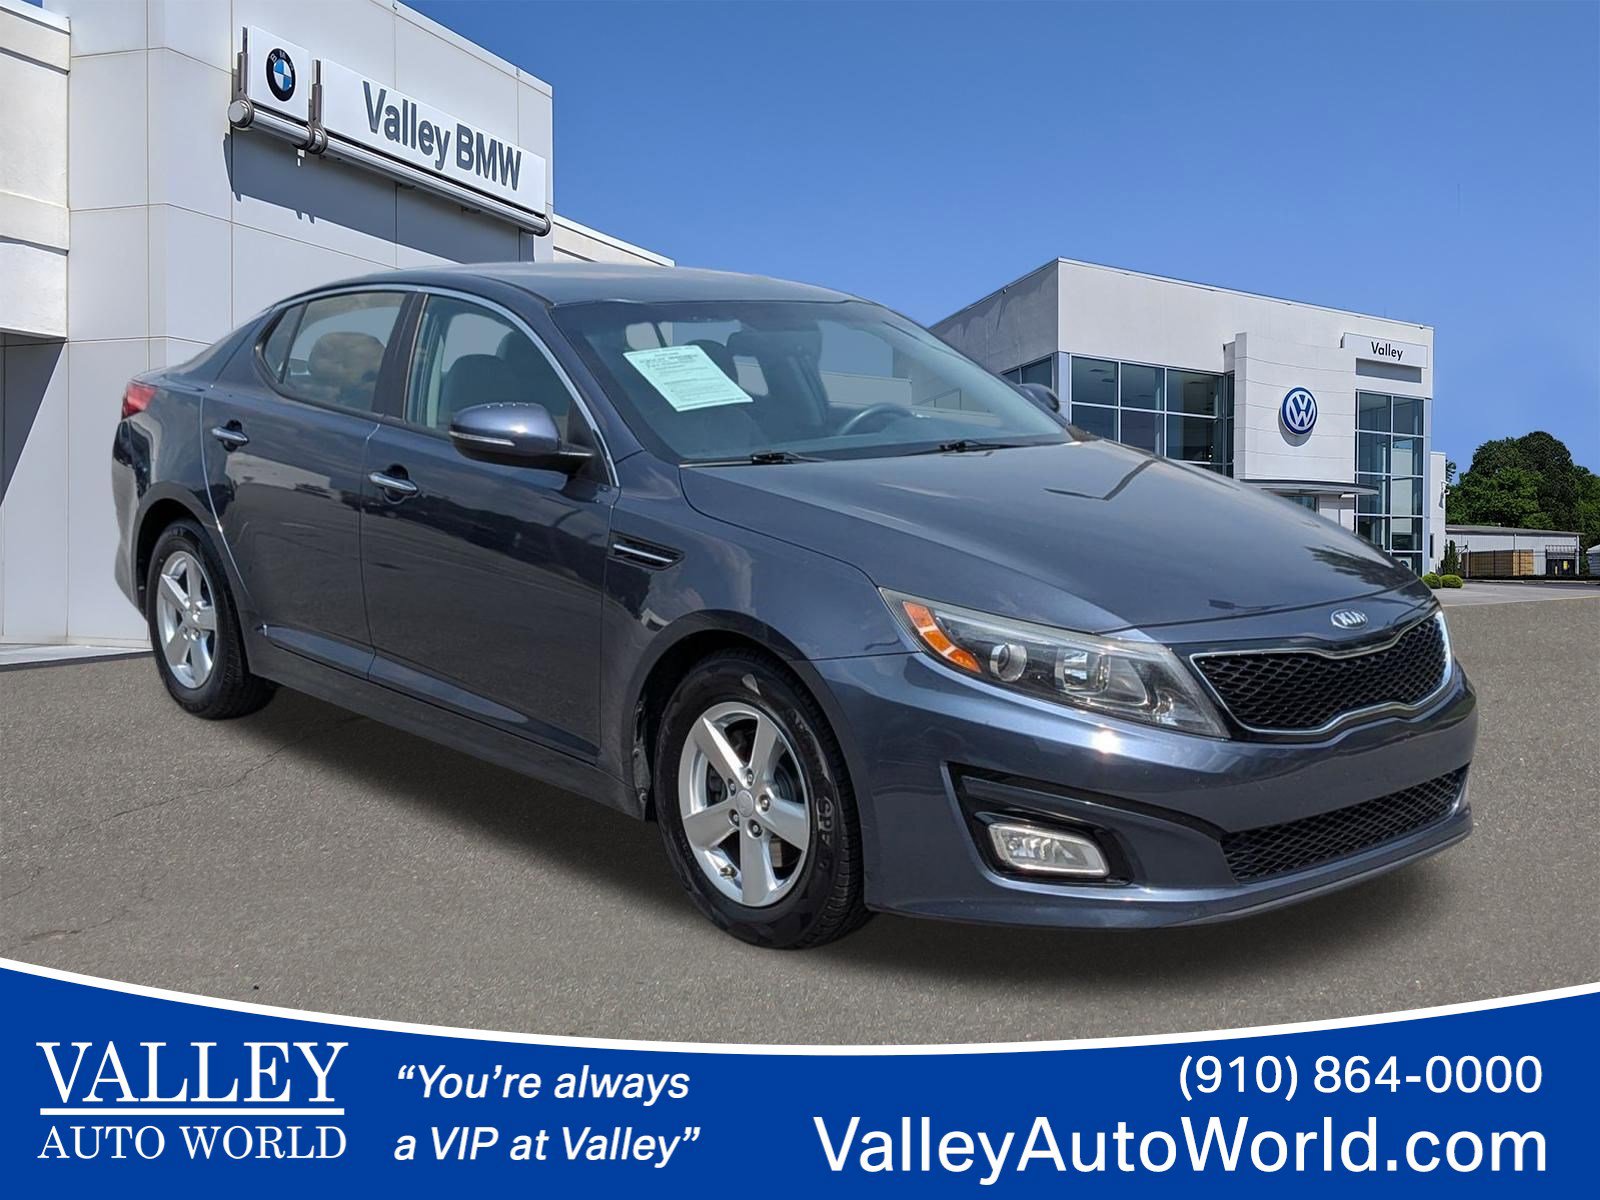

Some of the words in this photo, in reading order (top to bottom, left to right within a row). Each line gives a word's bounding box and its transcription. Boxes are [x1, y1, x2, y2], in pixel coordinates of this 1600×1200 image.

[362, 80, 450, 171] Valley
[455, 123, 522, 191] BMW
[1371, 341, 1403, 361] Valley
[1334, 610, 1367, 626] KIA
